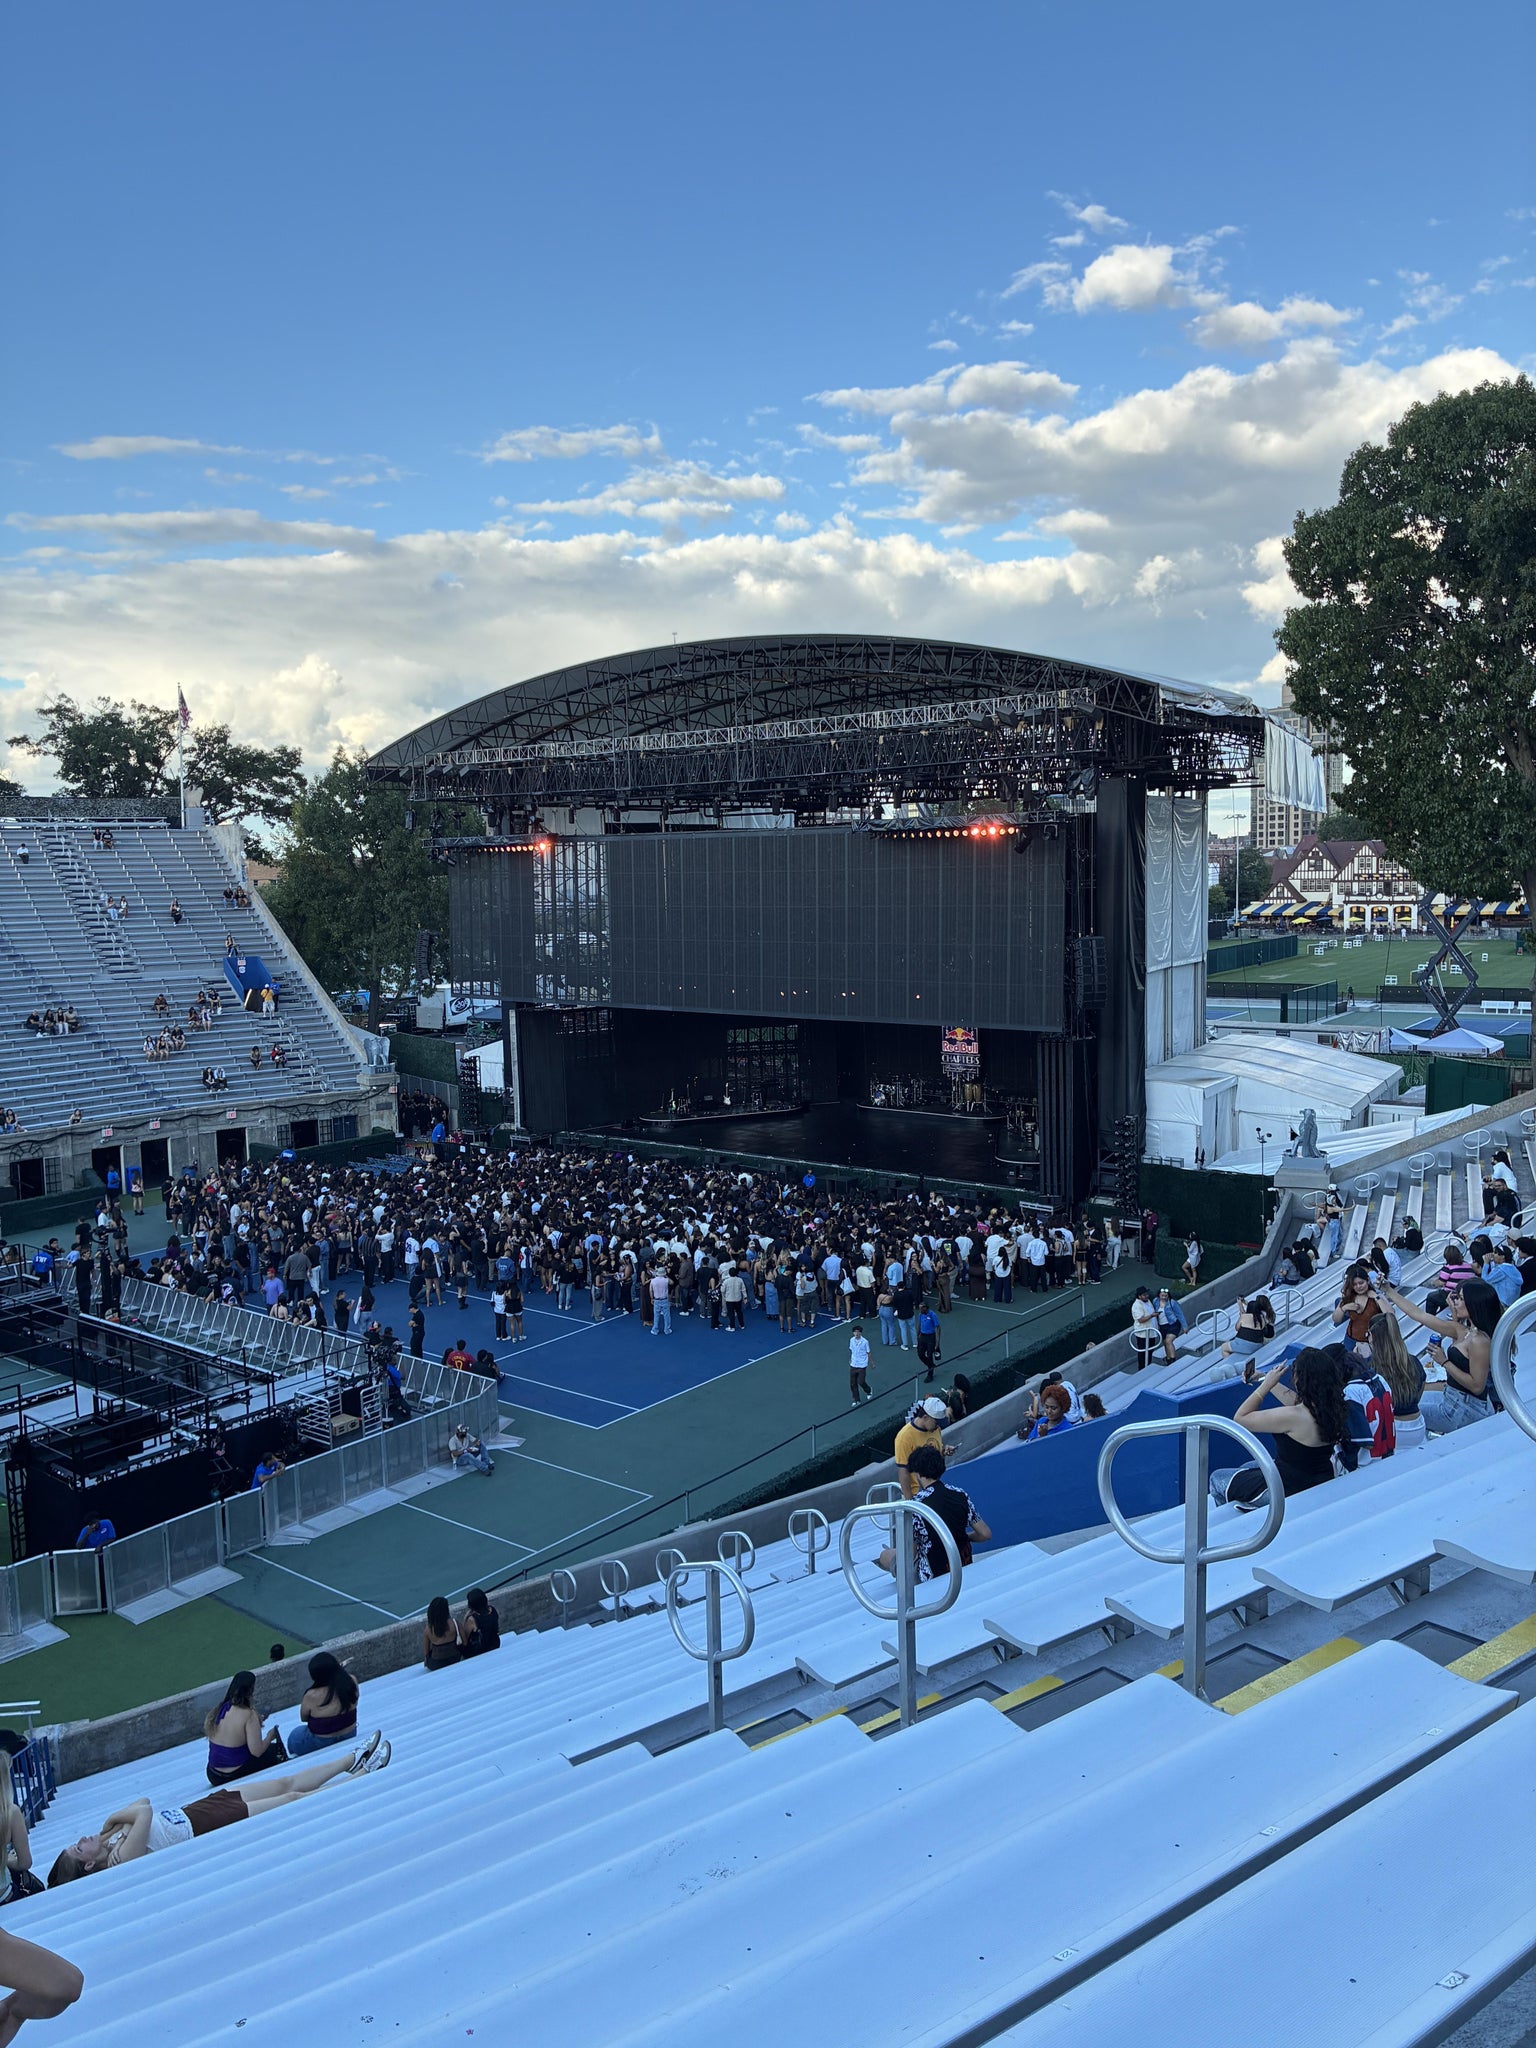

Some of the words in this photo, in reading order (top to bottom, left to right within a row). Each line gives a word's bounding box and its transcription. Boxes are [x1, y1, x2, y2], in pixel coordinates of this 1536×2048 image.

[942, 1041, 960, 1052] Red
[960, 1042, 978, 1054] Bull
[942, 1054, 980, 1064] CHAPTERS
